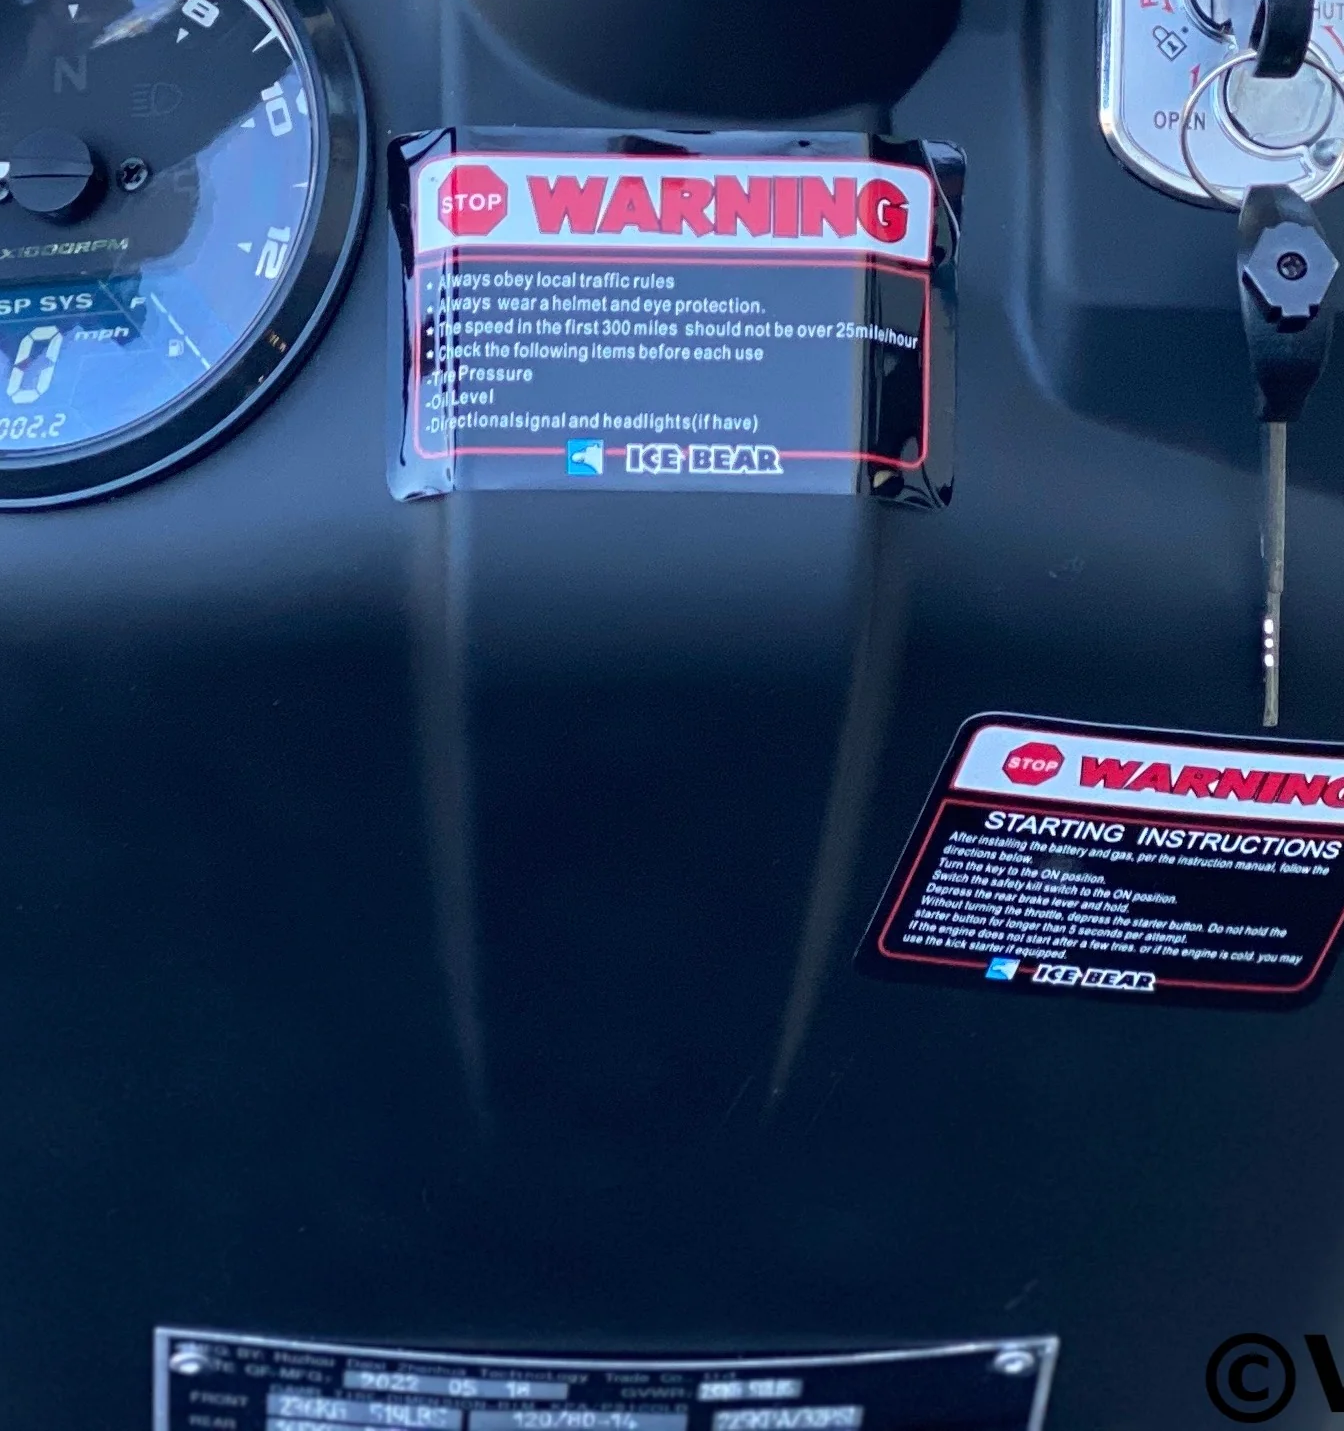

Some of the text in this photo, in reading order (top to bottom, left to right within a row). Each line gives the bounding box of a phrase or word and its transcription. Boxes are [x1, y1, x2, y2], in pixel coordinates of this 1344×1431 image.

[54, 55, 88, 92] N
[261, 81, 293, 137] 10
[441, 175, 909, 244] STOP WARNING
[255, 226, 291, 279] 12
[439, 270, 675, 290] Always obey local traffic rules
[40, 293, 93, 313] SYS
[130, 297, 147, 309] F
[440, 295, 766, 315] Always wear a helmet and eye protection.
[439, 321, 462, 337] The
[464, 317, 514, 337] speed
[518, 317, 533, 334] in
[536, 319, 562, 335] the
[565, 318, 599, 335] first
[602, 319, 631, 335] 300
[633, 320, 678, 335] miles
[685, 321, 741, 337] should
[744, 322, 771, 338] not
[774, 322, 793, 338] be
[797, 326, 833, 338] over
[7, 326, 130, 404] 0 mph
[485, 342, 510, 358] the
[514, 342, 588, 363] following
[591, 343, 635, 359] items
[639, 344, 690, 360] before
[694, 345, 731, 361] each
[735, 348, 764, 361] use
[459, 364, 533, 381] Pressure
[451, 388, 494, 406] Level
[568, 412, 600, 429] and
[626, 443, 784, 474] ICE BEAR
[1008, 756, 1059, 772] STOP
[984, 811, 1343, 860] STARTING INSTRUCTIONS
[943, 845, 996, 859] directions
[949, 832, 977, 842] After
[978, 835, 1027, 851] installing
[1029, 841, 1047, 851] the
[1048, 842, 1088, 857] battery
[1088, 848, 1111, 858] and
[1136, 853, 1156, 862] per
[1158, 853, 1175, 863] the
[1177, 855, 1233, 868] instruction
[1279, 862, 1311, 873] follow
[1312, 865, 1329, 875] the
[939, 857, 963, 869] Turn
[965, 861, 983, 871] the
[984, 863, 1005, 875] key
[1007, 866, 1018, 875] to
[1020, 867, 1038, 877] the
[1040, 868, 1060, 879] ON
[926, 882, 972, 896] Depress
[974, 889, 992, 899] the
[993, 892, 1017, 901] rear
[1018, 893, 1049, 905] brake
[1051, 897, 1079, 907] lever
[1080, 901, 1103, 910] and
[932, 869, 968, 882] Switch
[970, 875, 988, 885] the
[990, 877, 1024, 891] safety
[1025, 880, 1042, 890] kill
[1043, 884, 1077, 895] switch
[1079, 886, 1091, 896] to
[1092, 887, 1110, 897] the
[1113, 889, 1132, 899] ON
[914, 908, 950, 920] starter
[951, 912, 986, 924] button
[988, 916, 1004, 926] for
[1005, 918, 1041, 931] longer
[1042, 922, 1066, 932] than
[1068, 924, 1076, 934] 5
[1078, 927, 1122, 938] seconds
[1123, 931, 1143, 940] per
[921, 895, 963, 909] Without
[964, 900, 1002, 915] turning
[1004, 905, 1021, 915] the
[1067, 911, 1110, 924] depress
[1112, 915, 1131, 925] the
[1132, 918, 1167, 928] starter
[1207, 922, 1223, 933] Do
[1225, 925, 1243, 934] not
[1244, 925, 1269, 936] hold
[1269, 927, 1286, 937] the
[902, 934, 922, 943] use
[925, 935, 942, 945] the
[944, 937, 966, 948] kick
[969, 941, 1004, 952] starter
[1005, 944, 1014, 953] if
[908, 920, 918, 929] If
[918, 921, 936, 931] the
[938, 925, 975, 936] engine
[977, 928, 1004, 939] does
[1006, 931, 1024, 942] not
[1025, 934, 1051, 944] start
[1052, 936, 1078, 946] after
[1089, 939, 1109, 949] few
[1139, 945, 1152, 953] or
[1152, 944, 1162, 953] if
[1162, 946, 1179, 955] the
[1181, 948, 1217, 959] engine
[1218, 950, 1228, 959] is
[1256, 953, 1277, 963] you
[1279, 954, 1302, 965] may
[1032, 963, 1156, 991] ICE BEAR
[360, 1371, 419, 1391] 2022
[448, 1380, 477, 1397] 05
